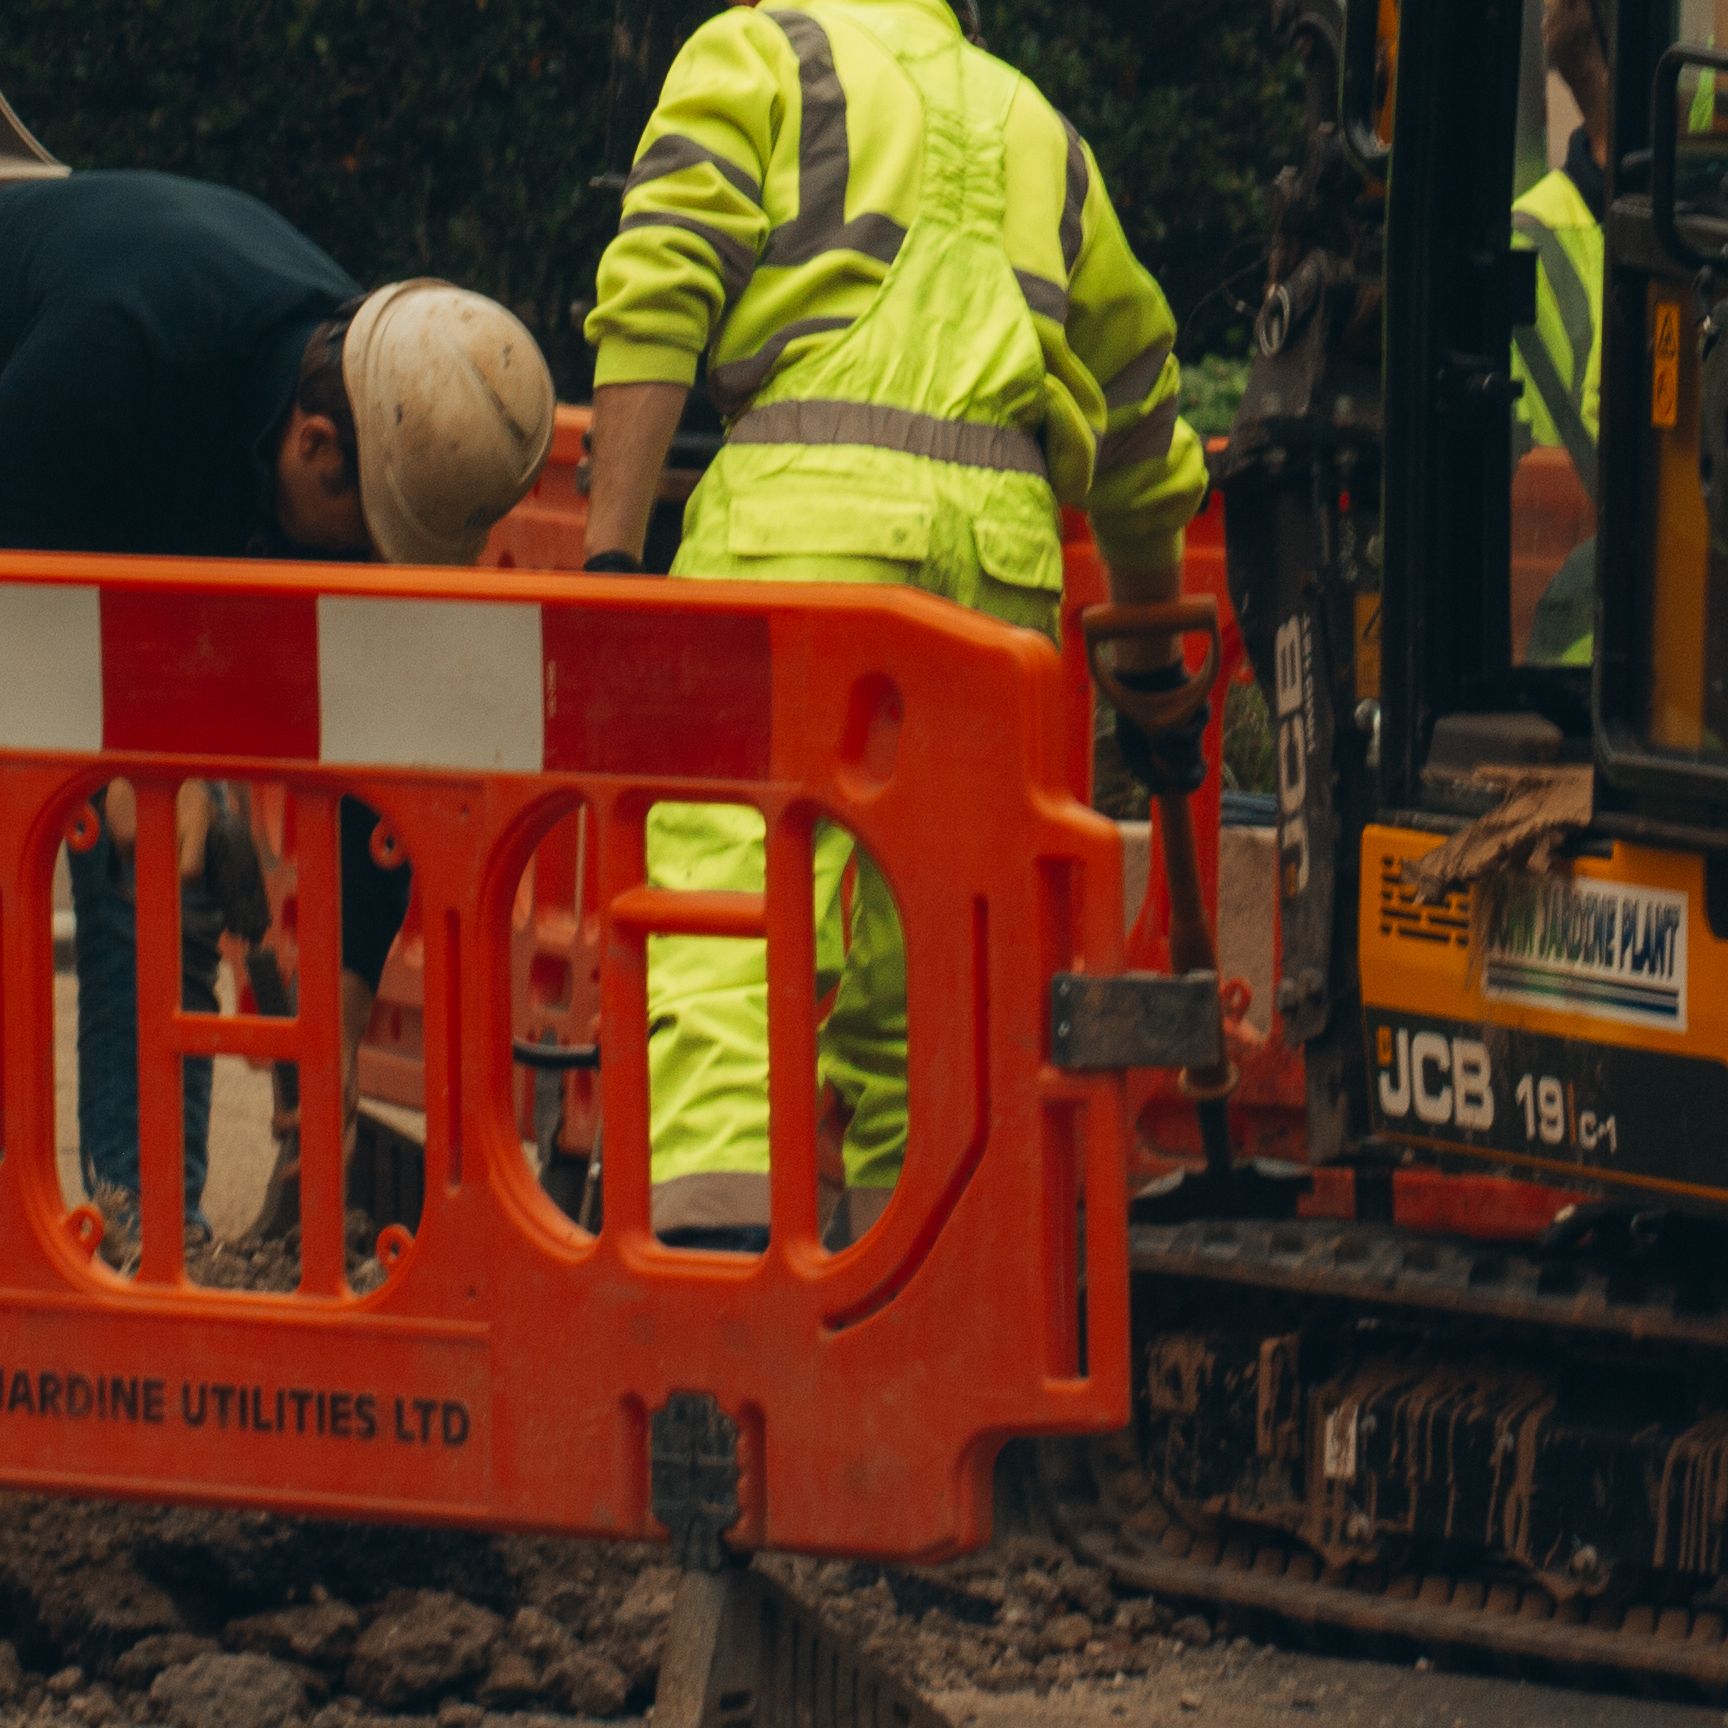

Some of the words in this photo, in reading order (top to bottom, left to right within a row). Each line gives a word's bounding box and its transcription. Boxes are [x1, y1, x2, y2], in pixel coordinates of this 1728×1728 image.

[1276, 613, 1311, 891] JCB
[1620, 894, 1682, 979] PLANT
[1378, 1028, 1495, 1132] JCB
[1515, 1072, 1566, 1145] 19
[181, 1380, 378, 1442] UTILITIES
[395, 1395, 471, 1448] LTD
